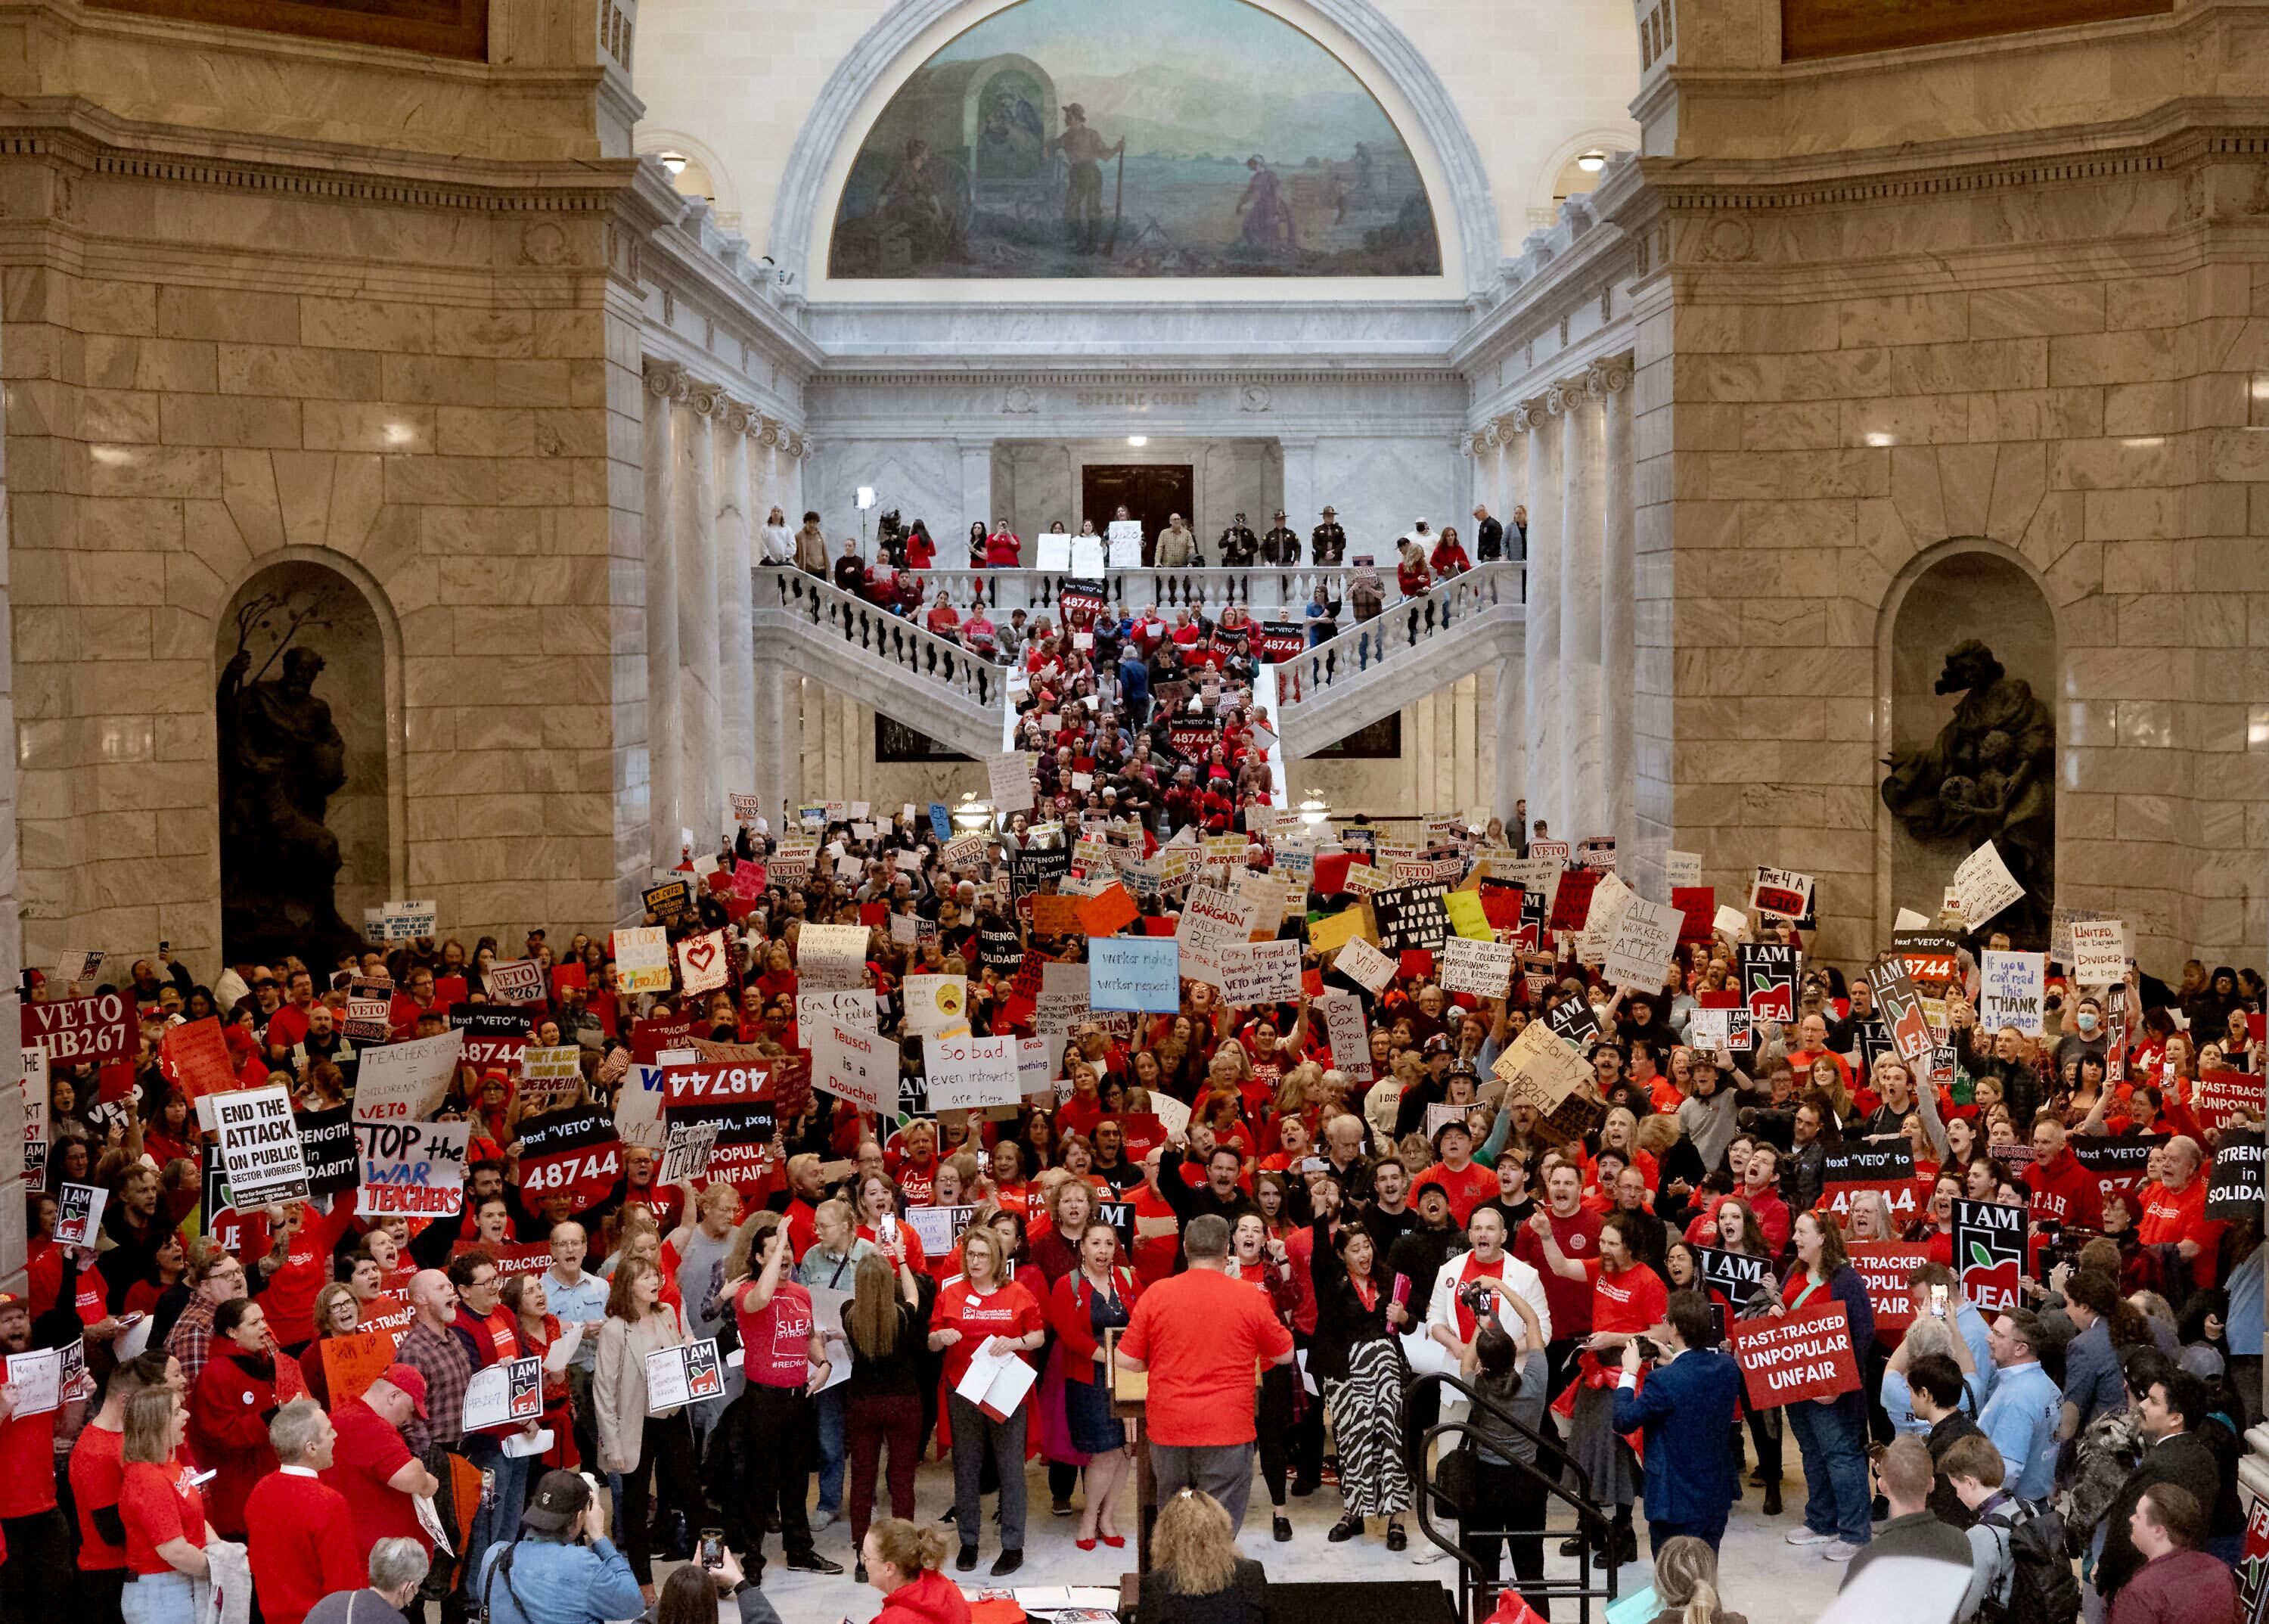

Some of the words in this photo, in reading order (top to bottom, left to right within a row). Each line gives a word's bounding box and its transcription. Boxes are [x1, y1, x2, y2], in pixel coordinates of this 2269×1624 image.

[1077, 393, 1146, 405] SUPREME
[1152, 393, 1198, 405] COURT
[1063, 597, 1100, 610] 48744
[1264, 639, 1300, 651] 48744
[1173, 734, 1213, 743] 48744
[731, 796, 755, 806] VETO
[950, 841, 979, 859] VETO
[1380, 849, 1413, 858] PROTECT
[1535, 846, 1565, 856] VETO
[1591, 853, 1615, 863] VETO
[957, 852, 984, 865] HB267
[1206, 855, 1246, 865] SERVE!!!
[771, 865, 802, 874] VETO
[1018, 862, 1036, 875] AM
[1398, 867, 1431, 877] VETO
[1758, 867, 1780, 884] TIME
[1782, 871, 1791, 887] 4
[1796, 878, 1804, 890] A
[1191, 886, 1238, 911] UNITED
[1378, 893, 1401, 906] LAY
[1414, 885, 1448, 900] DOWN
[1757, 888, 1802, 911] VETO
[1191, 901, 1245, 927] BARGAIN
[1398, 902, 1437, 918] YOUR
[1628, 902, 1658, 922] ALL
[1183, 913, 1229, 936] DIVIDED
[1388, 914, 1451, 931] WEAPONS
[1383, 935, 1398, 949] OF
[1408, 930, 1443, 944] WAR!
[1622, 921, 1669, 942] WORKERS
[2075, 927, 2113, 939] UNITED,
[690, 935, 709, 946] WE
[2092, 939, 2122, 949] bargain
[1252, 946, 1283, 960] Friend
[1287, 944, 1297, 956] of
[1475, 952, 1512, 963] COLLECTIVE
[1613, 938, 1671, 964] ATTACK
[1745, 946, 1752, 961] I
[1757, 946, 1790, 962] AM
[1103, 952, 1138, 965] worker
[1143, 950, 1173, 969] rights
[1267, 961, 1278, 970] Put
[1356, 952, 1378, 974] VETO
[1445, 958, 1491, 970] BARGAINING
[1987, 957, 1995, 969] If
[2001, 962, 2026, 973] you
[495, 969, 534, 986] VETO
[1445, 967, 1457, 977] DO
[1460, 968, 1467, 977] A
[1470, 970, 1509, 981] DISSERVICE
[1870, 969, 1877, 983] I
[1880, 961, 1905, 984] AM
[2012, 971, 2034, 984] read
[2078, 969, 2094, 977] we
[2101, 969, 2118, 978] beg
[1097, 977, 1132, 991] worker
[1225, 980, 1249, 991] VETO
[1252, 973, 1273, 986] where
[504, 985, 542, 999] HB267
[1225, 993, 1246, 1004] Words
[1247, 991, 1264, 1001] are!
[833, 994, 860, 1009] Cox
[1329, 1001, 1352, 1014] Gov.
[1987, 995, 2038, 1015] THANK
[2112, 993, 2125, 1012] AM
[34, 995, 123, 1030] VETO
[352, 1005, 385, 1015] VETO
[1552, 996, 1585, 1027] AM
[1733, 1012, 1749, 1021] AM
[1749, 1004, 1787, 1020] UEA
[452, 1016, 473, 1025] text
[520, 1017, 530, 1026] to
[1329, 1016, 1358, 1026] Cox:
[1985, 1016, 1991, 1027] a
[1997, 1012, 2038, 1028] teacher
[344, 1023, 384, 1036] HB267
[33, 1024, 126, 1060] HB267
[833, 1026, 871, 1054] Teusch
[1023, 1039, 1042, 1050] Grab
[1342, 1042, 1355, 1051] up
[1730, 1039, 1747, 1047] UEA
[1898, 1033, 1933, 1060] UEA
[458, 1044, 526, 1064] 48744
[941, 1044, 964, 1060] So
[972, 1041, 1007, 1059] bad.
[1337, 1051, 1355, 1060] for
[1524, 1023, 1584, 1080] Solidarity
[1938, 1049, 1953, 1058] AM
[843, 1056, 852, 1071] is
[859, 1066, 865, 1076] a
[669, 1068, 768, 1097] 48744
[931, 1075, 964, 1084] even
[969, 1070, 1015, 1082] introverts
[1932, 1070, 1954, 1080] UEA
[829, 1076, 877, 1105] Douche!
[899, 1077, 930, 1095] AM
[951, 1093, 971, 1104] are
[979, 1093, 1008, 1104] here.
[222, 1104, 254, 1124] END
[256, 1098, 287, 1117] THE
[359, 1102, 407, 1119] VETO
[746, 1115, 771, 1127] text
[226, 1119, 293, 1149] ATTACK
[520, 1132, 546, 1145] text
[599, 1116, 612, 1127] to
[308, 1150, 319, 1161] in
[424, 1136, 463, 1162] the
[2076, 1150, 2100, 1159] text
[210, 1147, 220, 1168] I
[228, 1156, 249, 1171] ON
[251, 1144, 299, 1167] PUBLIC
[1826, 1157, 1848, 1168] text
[1895, 1154, 1909, 1165] to
[231, 1171, 262, 1184] SECTOR
[264, 1163, 302, 1177] WORKERS
[366, 1161, 432, 1185] WAR
[524, 1150, 619, 1191] 48744
[2242, 1169, 2257, 1181] in
[70, 1191, 89, 1204] AM
[365, 1183, 461, 1213] TEACHERS
[953, 1211, 955, 1221] I
[1958, 1201, 1969, 1224] I
[1975, 1206, 2020, 1231] AM
[57, 1223, 83, 1239] UEA
[918, 1225, 937, 1234] our
[1701, 1250, 1709, 1273] I
[1716, 1259, 1762, 1284] AM
[1962, 1283, 2016, 1312] UEA
[778, 1319, 811, 1333] SLEA
[1738, 1315, 1845, 1350] FAST-TRACKED
[67, 1344, 82, 1363] AM
[684, 1348, 688, 1362] I
[690, 1343, 712, 1360] AM
[1743, 1334, 1848, 1371] UNPOPULAR
[511, 1366, 514, 1379] I
[517, 1362, 537, 1377] AM
[1768, 1361, 1836, 1390] UNFAIR
[690, 1383, 719, 1396] UEA
[512, 1402, 537, 1416] UEA
